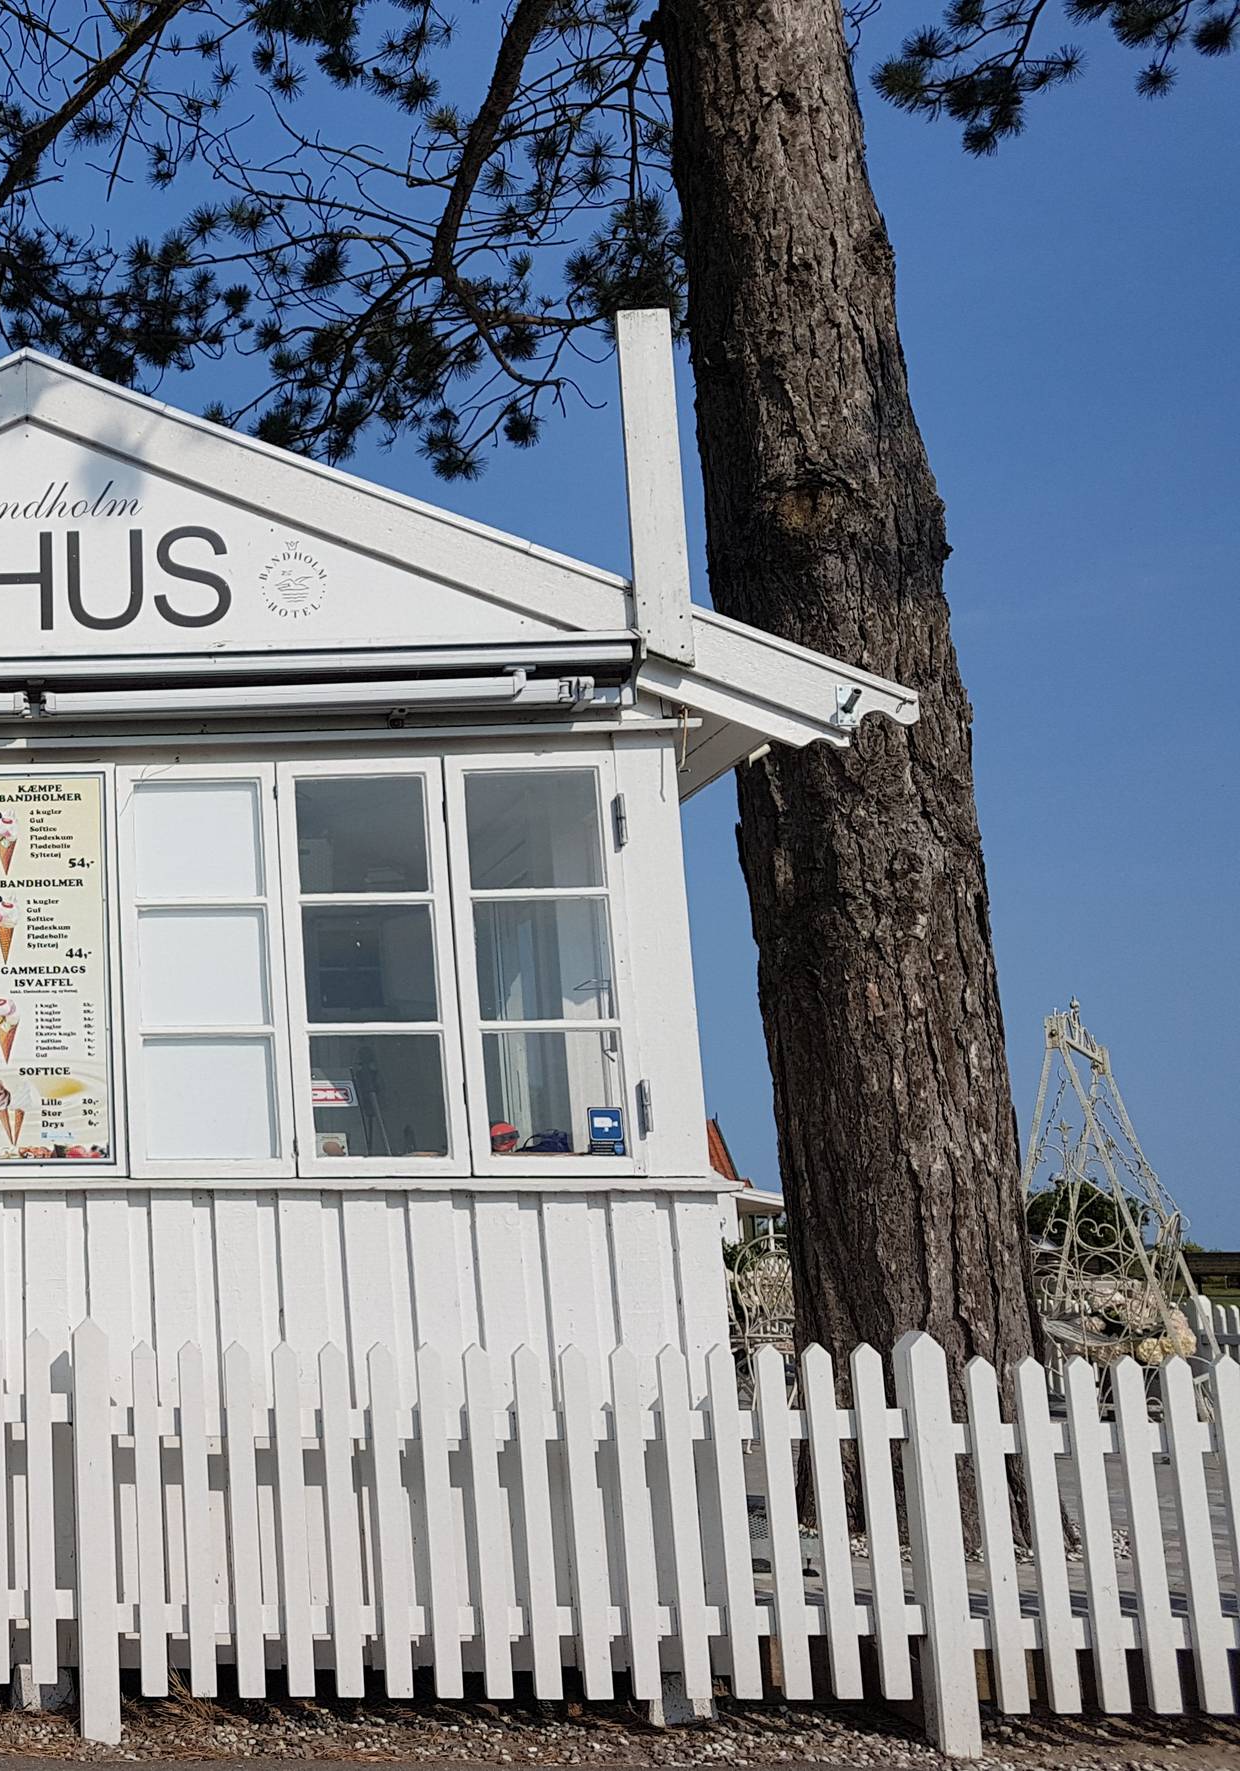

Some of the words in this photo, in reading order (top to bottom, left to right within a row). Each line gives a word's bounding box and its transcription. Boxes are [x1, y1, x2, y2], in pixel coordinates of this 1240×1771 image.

[17, 784, 63, 793] KÆMPE
[36, 808, 62, 816] kugler
[0, 878, 84, 889] BANDHOLMER
[32, 898, 59, 906] kugler
[27, 942, 59, 950] Syltetøj
[0, 965, 87, 975] GAMMELDAGS
[14, 978, 74, 988] ISVAFFEL
[19, 1066, 71, 1076] SOFTICE
[41, 1098, 62, 1106] Lille
[41, 1109, 63, 1117] Stor
[41, 1120, 65, 1129] Drys
